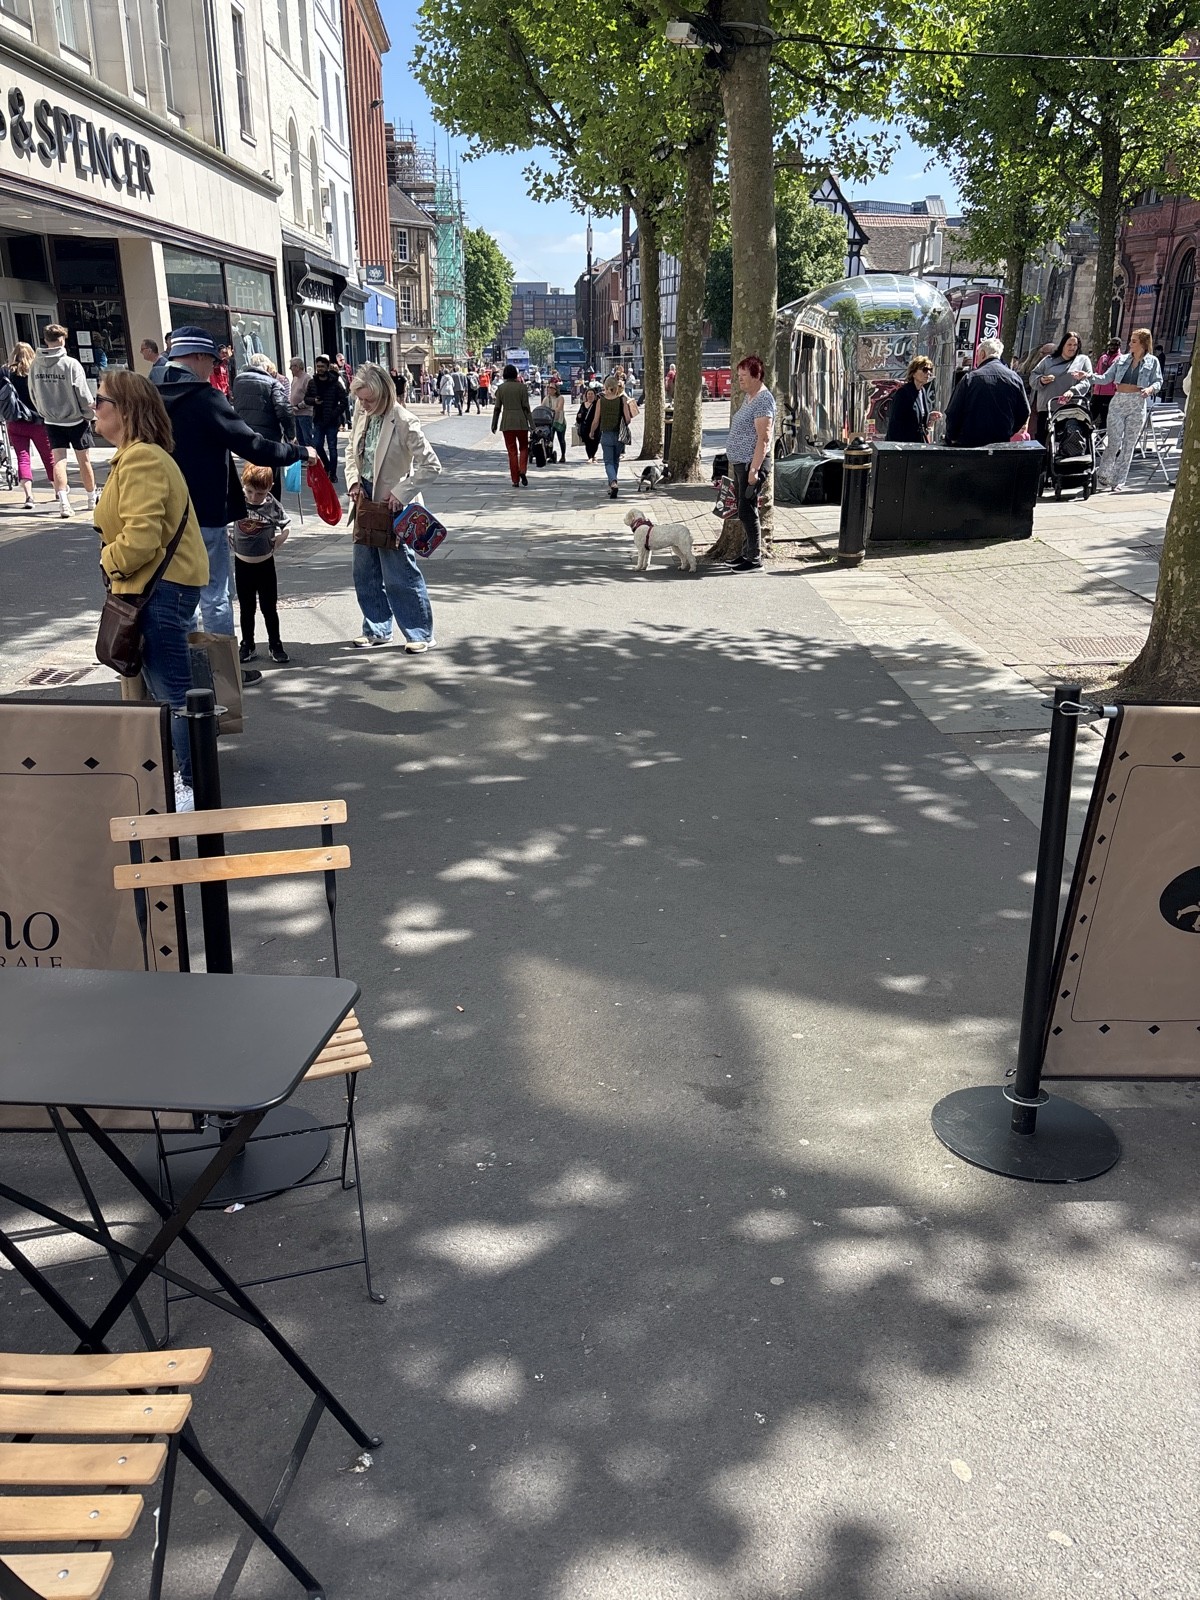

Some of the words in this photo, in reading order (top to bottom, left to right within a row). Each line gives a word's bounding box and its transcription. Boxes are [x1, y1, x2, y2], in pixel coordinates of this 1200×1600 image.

[8, 87, 36, 154] &
[34, 98, 155, 196] SPENCER
[870, 338, 906, 357] itsu
